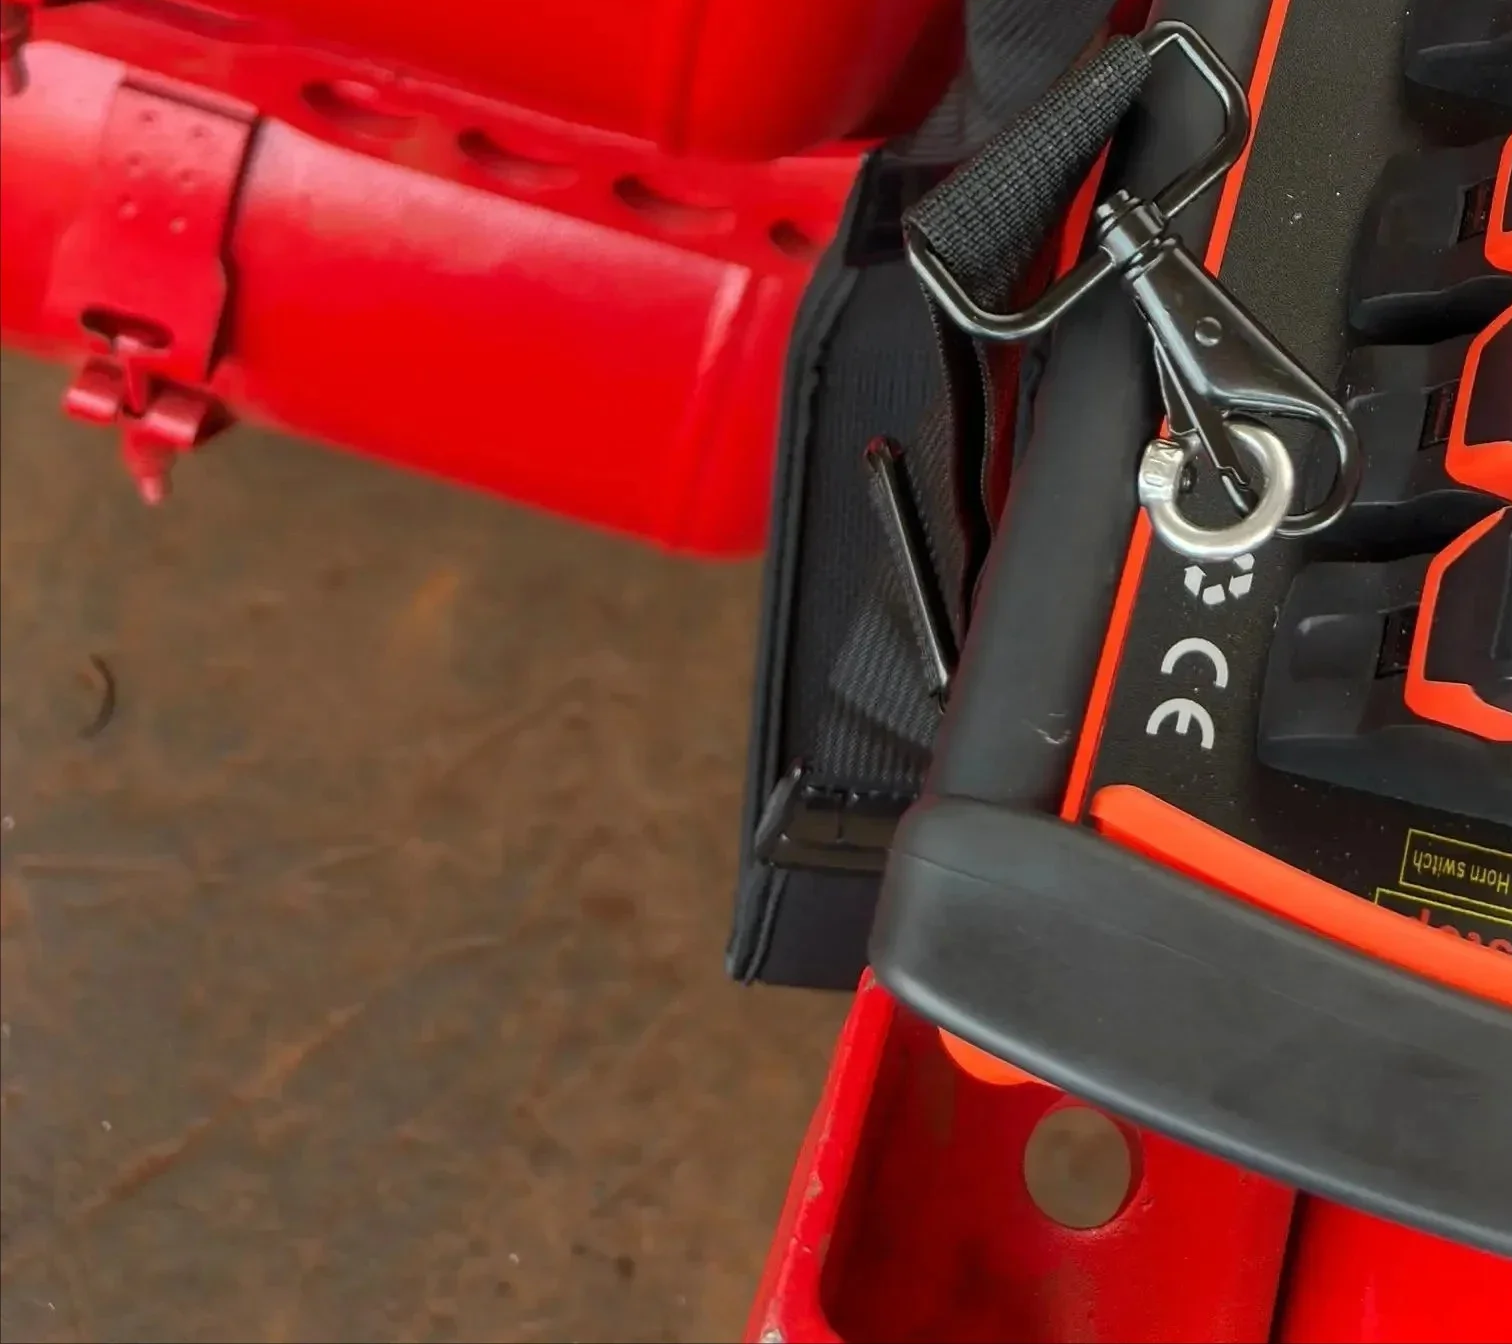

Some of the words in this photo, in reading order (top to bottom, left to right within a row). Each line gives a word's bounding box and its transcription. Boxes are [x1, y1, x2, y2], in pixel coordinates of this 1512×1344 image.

[1145, 637, 1229, 751] CE
[1412, 849, 1467, 881] switch
[1470, 864, 1511, 895] Horn
